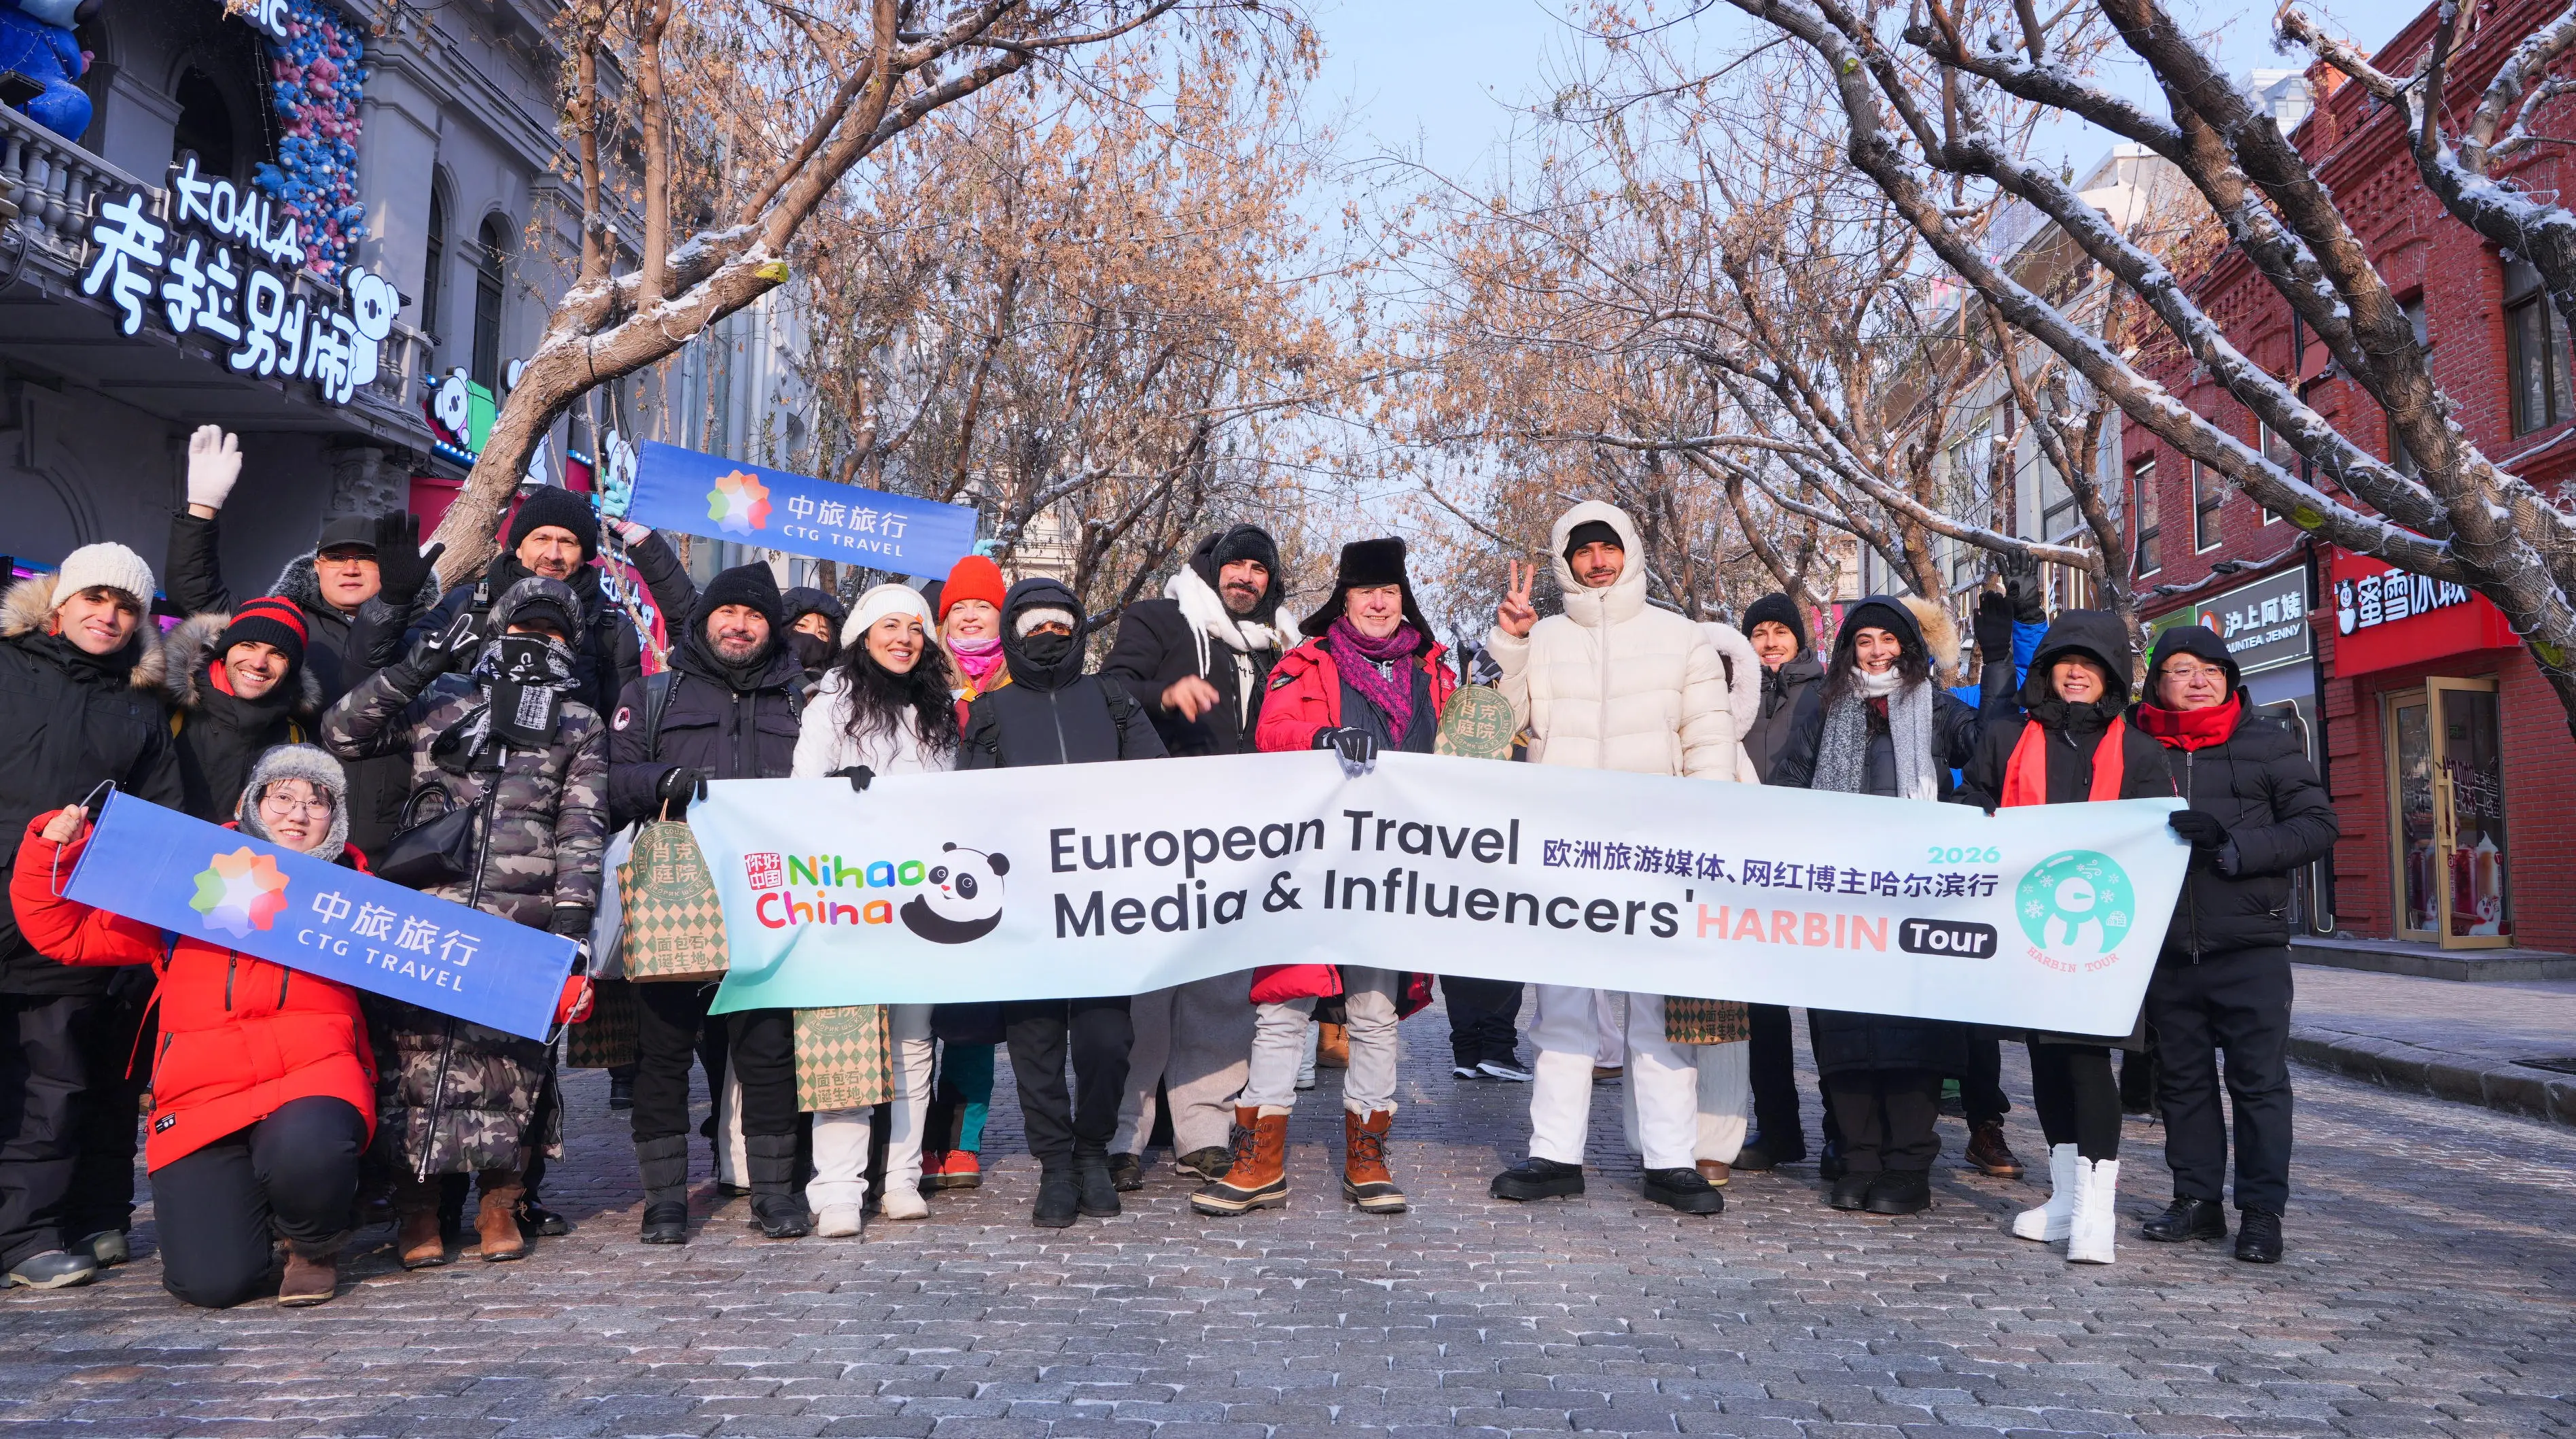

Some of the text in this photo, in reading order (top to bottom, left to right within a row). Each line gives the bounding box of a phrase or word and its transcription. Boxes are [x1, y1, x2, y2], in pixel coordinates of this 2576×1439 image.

[176, 158, 304, 264] KOALA
[84, 193, 357, 404] 考拉别闹
[787, 494, 908, 539] 中旅旅行
[783, 524, 904, 557] CTG TRAVEL
[2223, 591, 2301, 639] 沪上阿姨
[2225, 623, 2301, 653] AUNTEA JENNY
[1457, 719, 1496, 739] 庭院
[653, 842, 696, 863] 肖克
[1050, 809, 1519, 879] European Travel
[1929, 846, 2000, 864] 2026
[652, 864, 699, 884] 庭院
[745, 852, 781, 871] 你好
[788, 854, 926, 888] Nihao
[1543, 838, 1998, 898] 欧洲旅游媒体、网红博主哈尔滨行
[750, 871, 782, 890] 中国
[756, 890, 893, 929] China
[1054, 879, 1248, 939] Media
[1262, 871, 1303, 913] &
[1698, 904, 1888, 951] HARBIN
[1909, 923, 1988, 953] Tour
[312, 891, 481, 967] 中旅旅行
[657, 936, 707, 952] 面包石
[298, 929, 462, 992] CTG TRAVEL
[657, 952, 708, 969] 诞生地
[2026, 946, 2120, 973] HARBIN TOUR
[816, 1071, 860, 1088] 面包石
[817, 1087, 864, 1104] 诞生地
